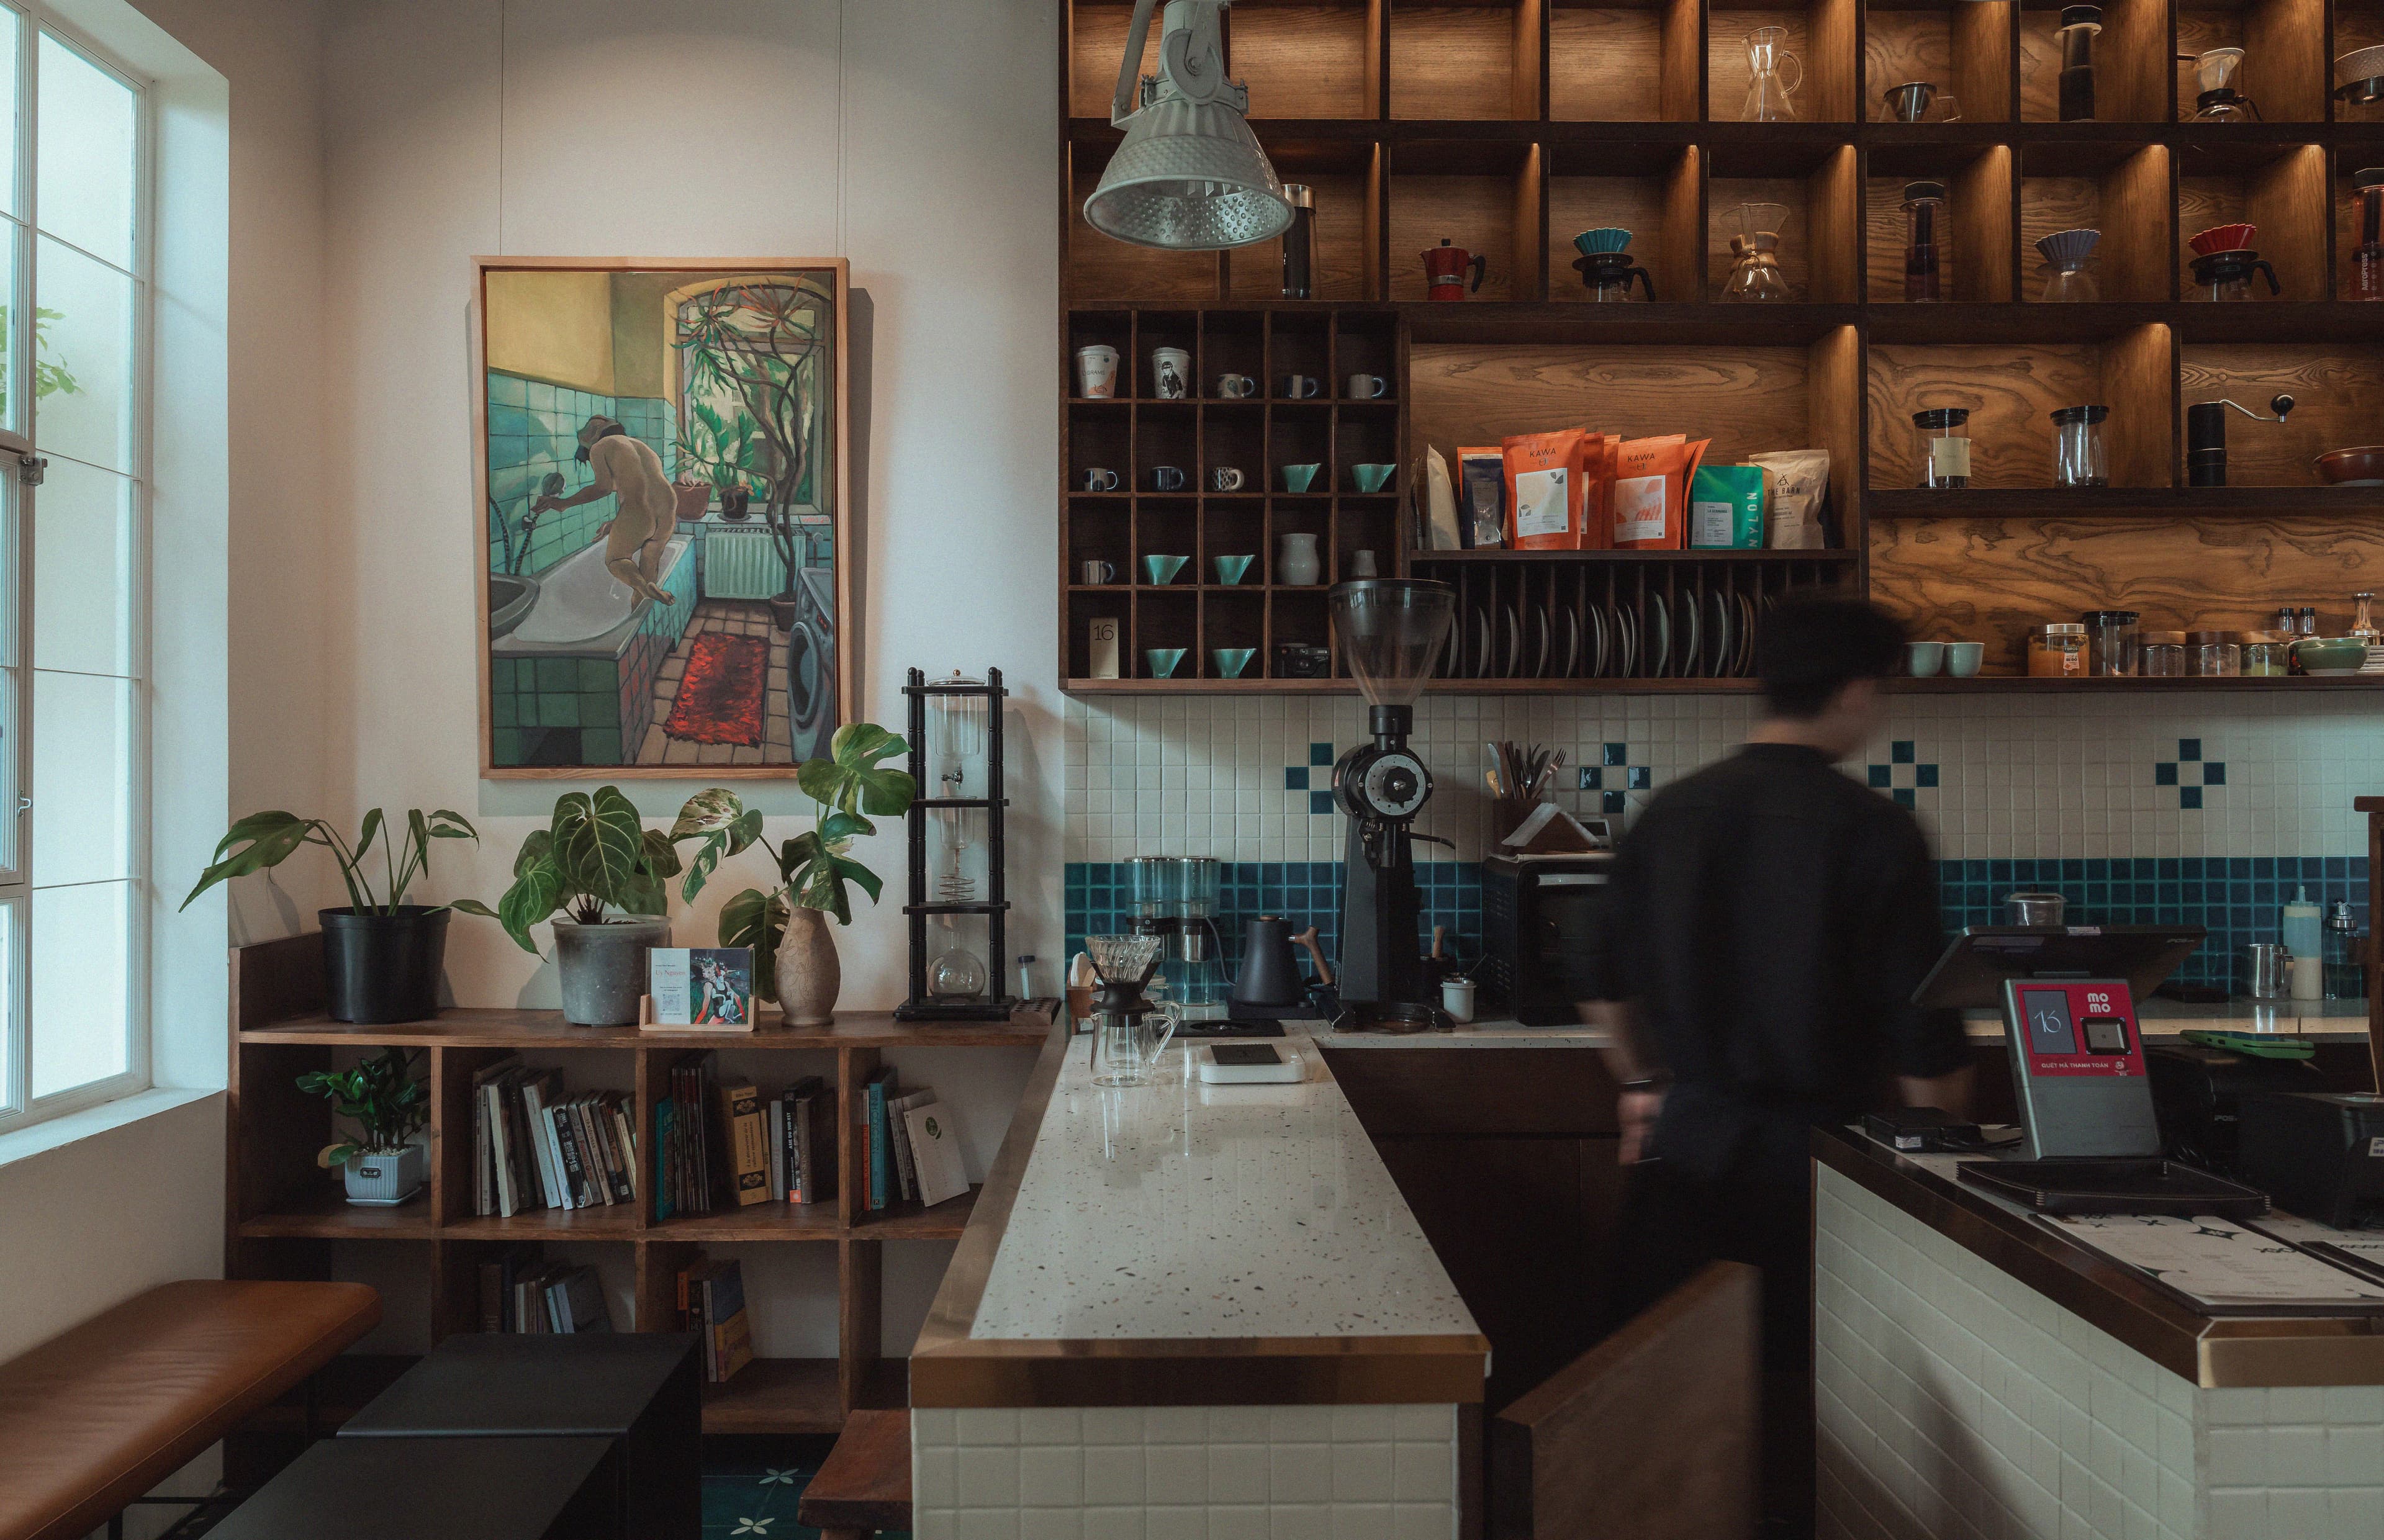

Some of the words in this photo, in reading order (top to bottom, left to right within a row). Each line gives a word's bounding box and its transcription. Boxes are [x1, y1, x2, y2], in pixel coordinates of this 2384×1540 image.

[1530, 448, 1556, 458] KAWA
[1628, 453, 1655, 462] KAWA
[1768, 489, 1779, 497] THE
[1746, 492, 1759, 547] NYLON
[1093, 624, 1114, 641] 16
